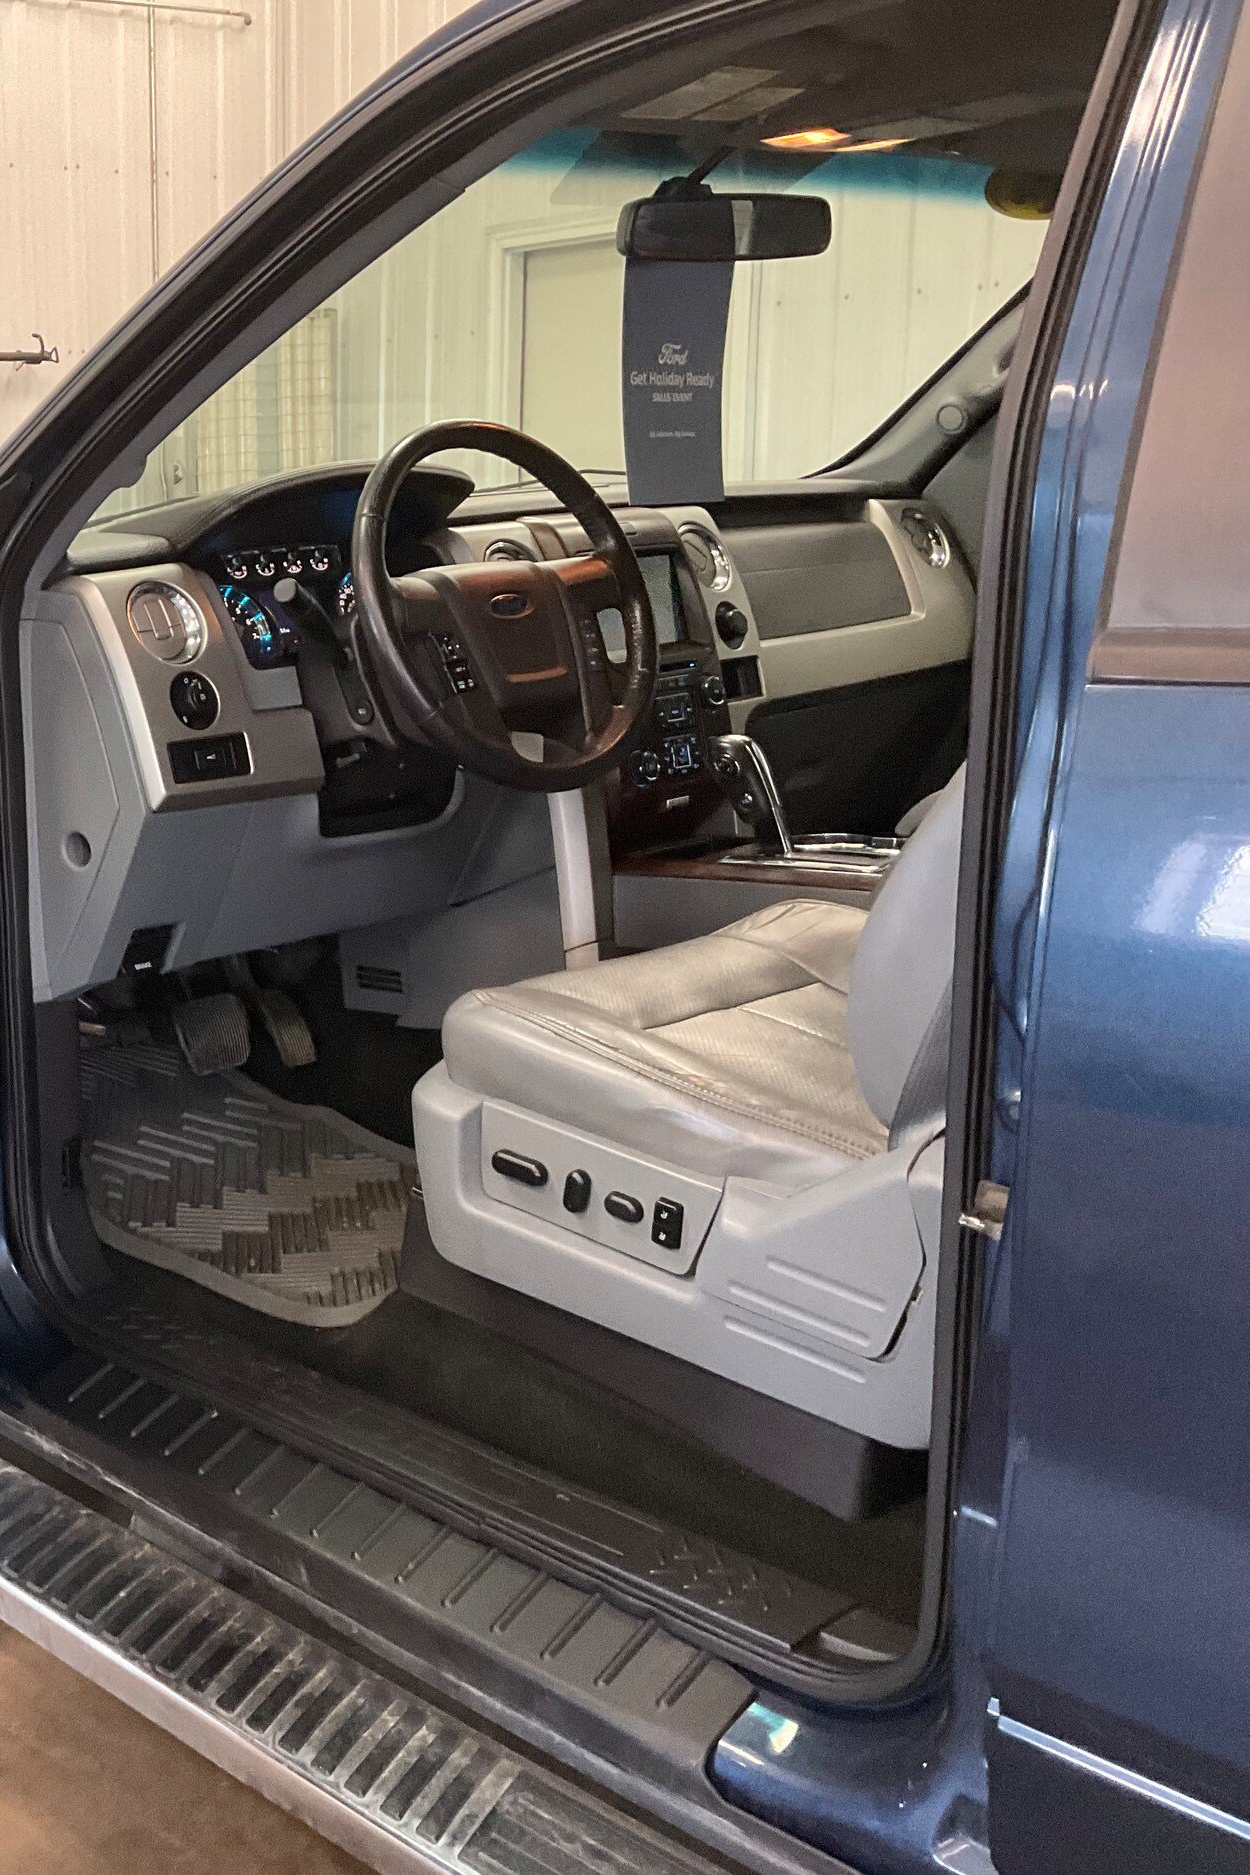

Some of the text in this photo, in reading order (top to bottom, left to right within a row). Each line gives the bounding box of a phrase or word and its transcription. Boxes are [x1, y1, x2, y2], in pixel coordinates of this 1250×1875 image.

[658, 343, 689, 365] Ford
[630, 371, 715, 389] Get Holiday Ready
[672, 392, 694, 402] EVENT
